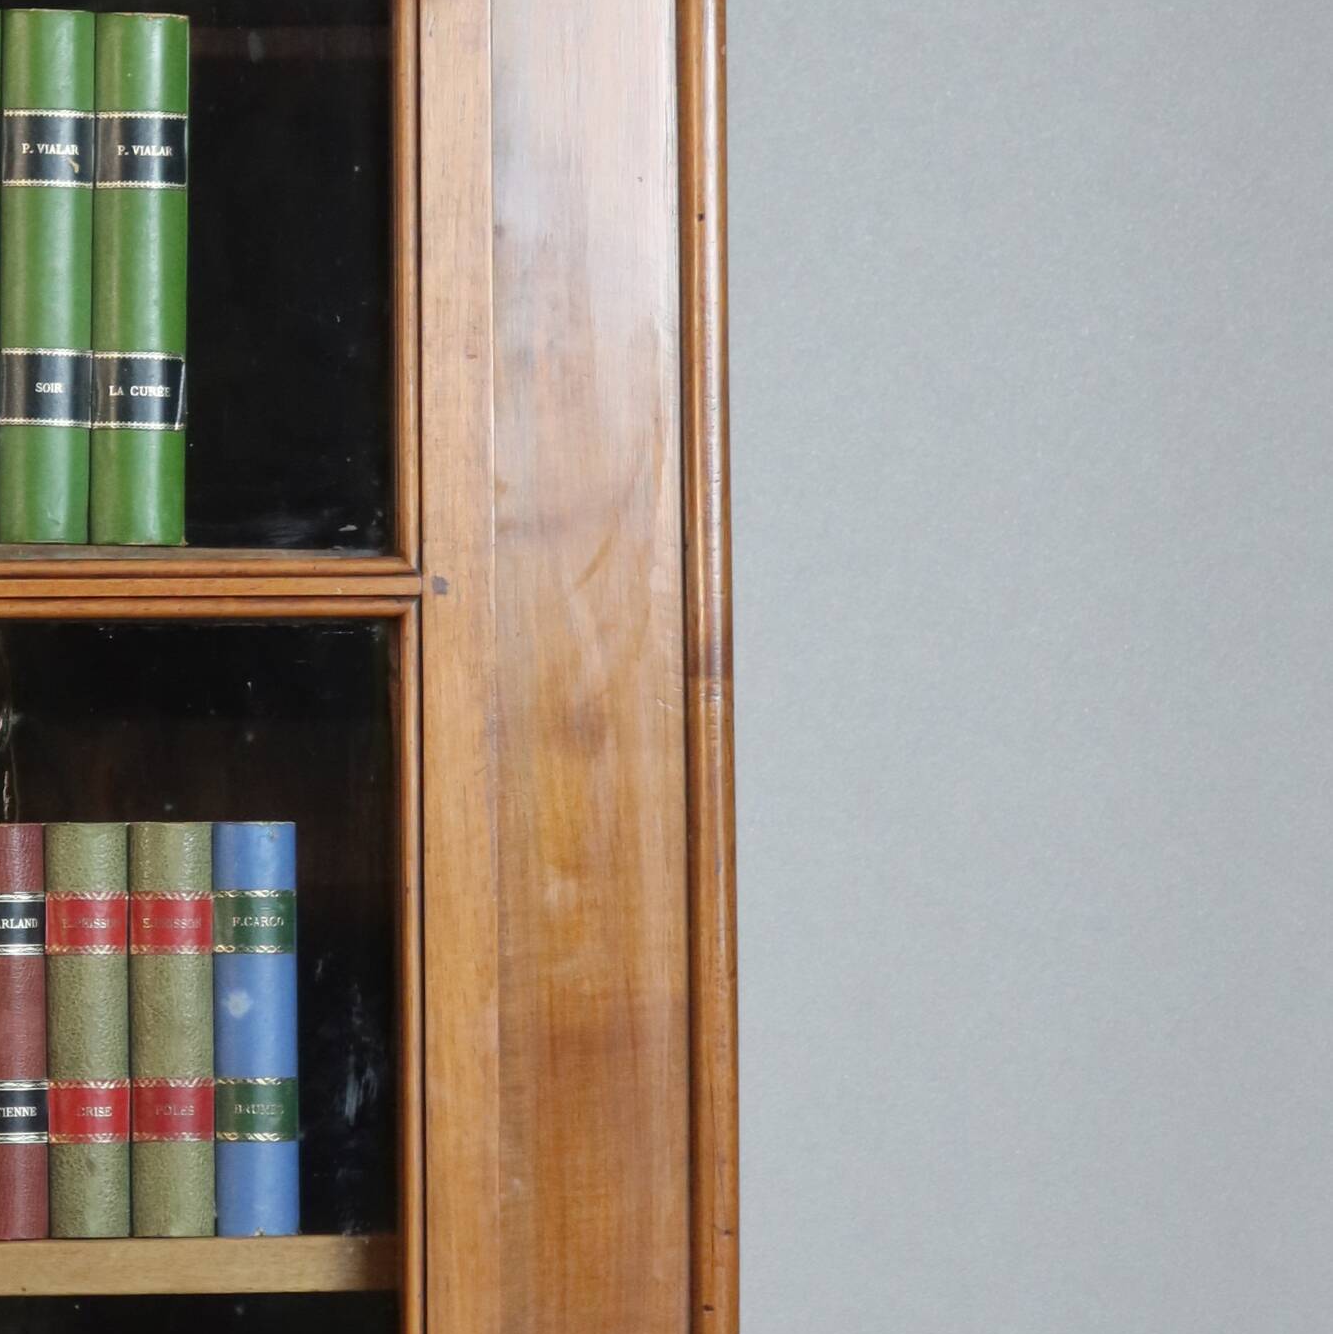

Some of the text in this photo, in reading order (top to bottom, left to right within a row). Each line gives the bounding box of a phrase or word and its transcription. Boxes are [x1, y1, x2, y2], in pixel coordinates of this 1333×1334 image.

[37, 142, 79, 156] VIALAR
[132, 144, 173, 157] VIALAR
[35, 381, 63, 394] SOIR
[109, 384, 124, 397] LA
